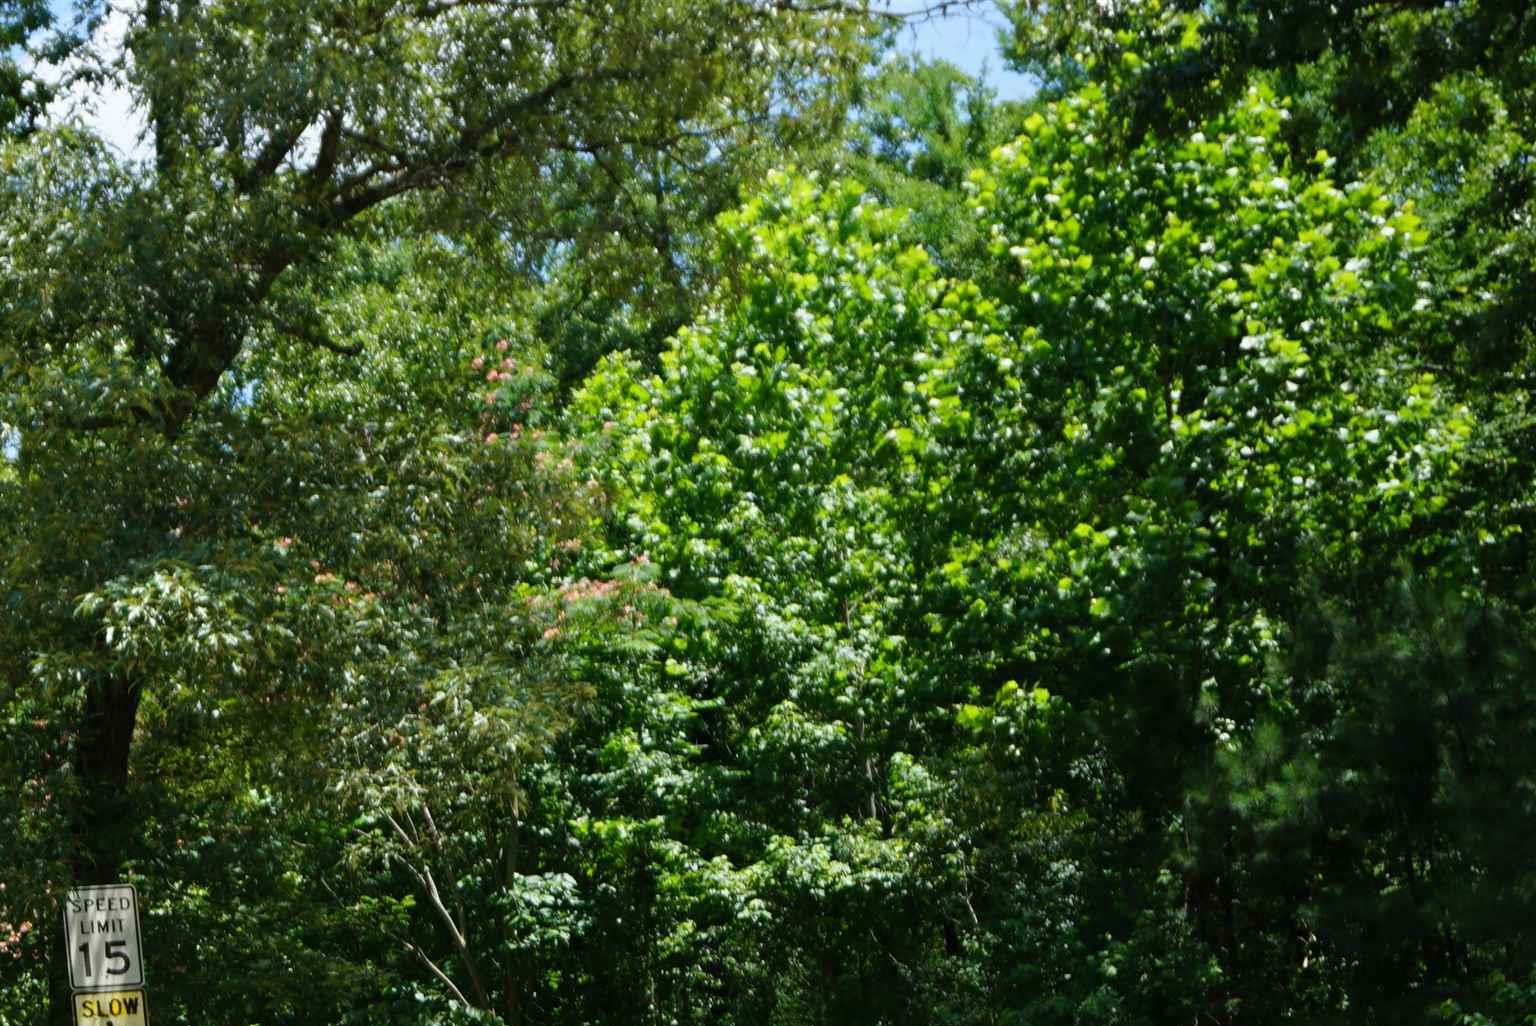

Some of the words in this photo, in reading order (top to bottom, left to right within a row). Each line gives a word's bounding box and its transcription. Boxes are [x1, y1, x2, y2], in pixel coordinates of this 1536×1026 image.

[72, 897, 130, 912] SPEED
[80, 919, 124, 934] LIMIT
[79, 941, 130, 977] 15
[82, 997, 138, 1018] SLOW
